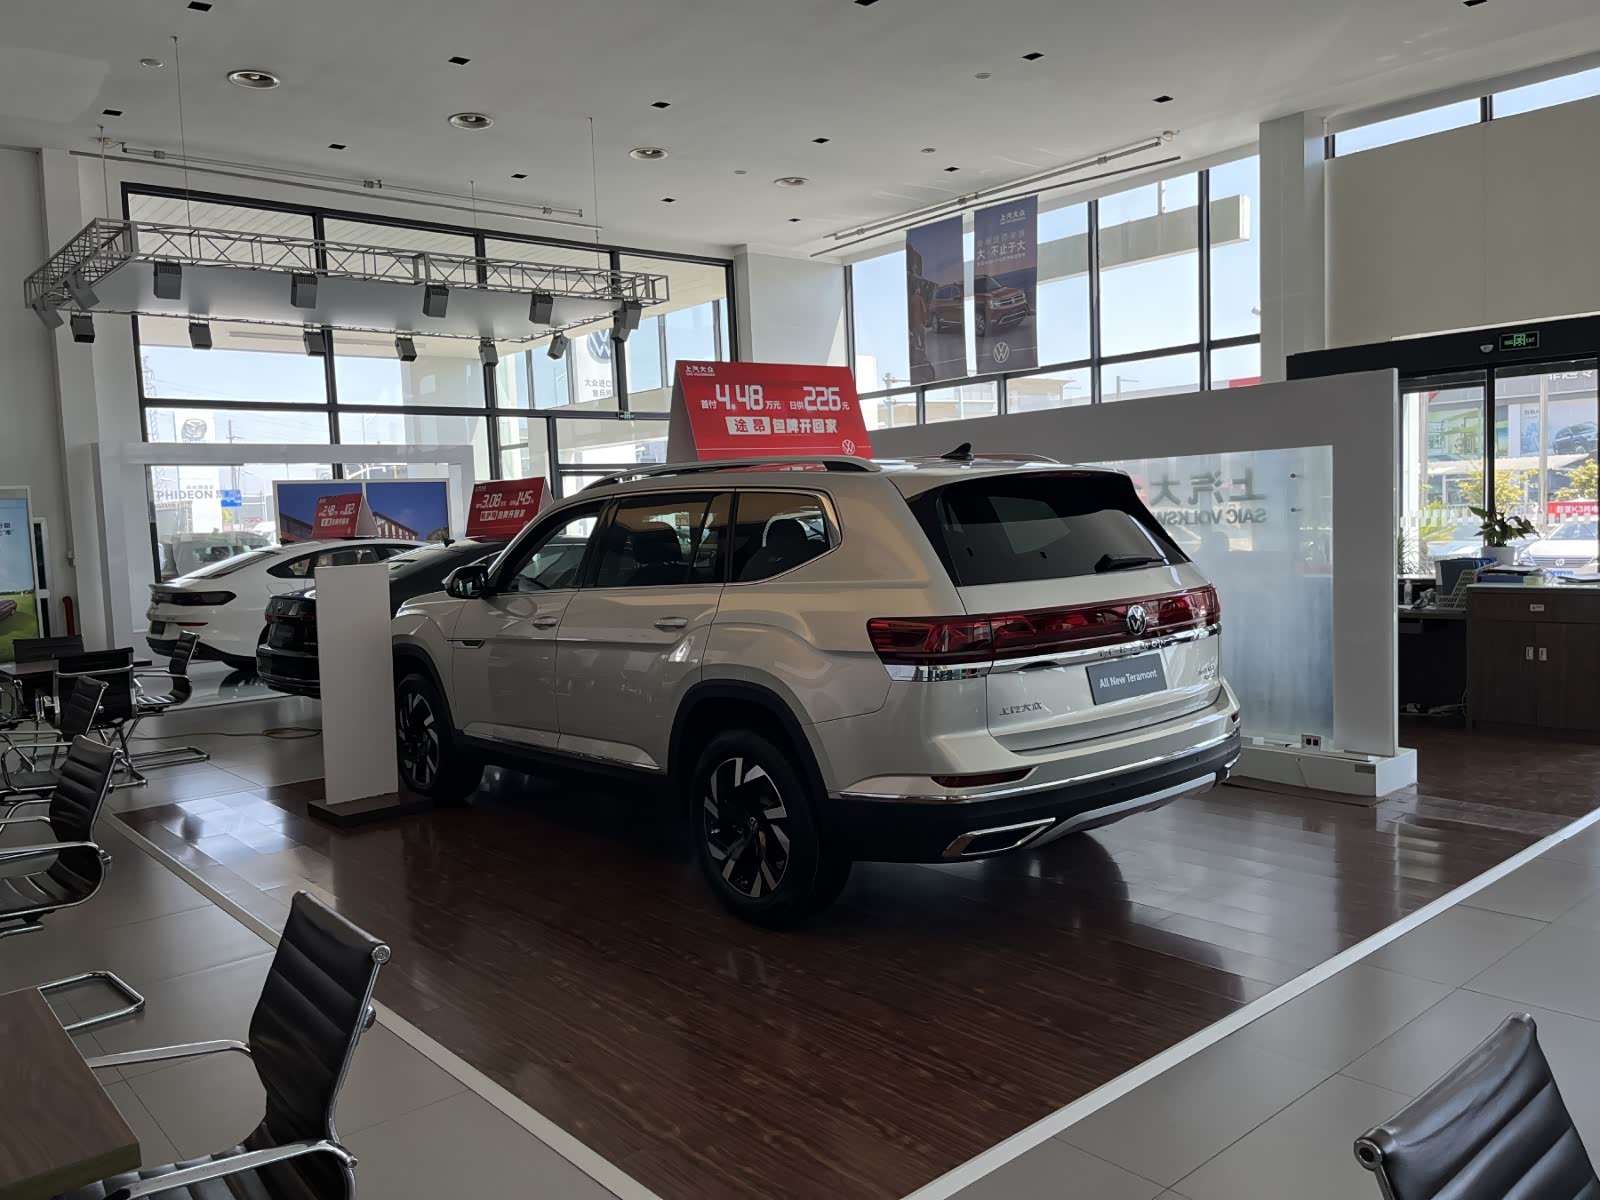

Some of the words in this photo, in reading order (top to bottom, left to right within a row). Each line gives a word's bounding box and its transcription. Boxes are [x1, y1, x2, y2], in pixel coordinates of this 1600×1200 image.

[685, 364, 715, 373] 上汽大众
[156, 490, 214, 500] PHIDEON
[1099, 678, 1109, 689] All
[1109, 673, 1126, 686] New
[1126, 668, 1158, 683] Teramont
